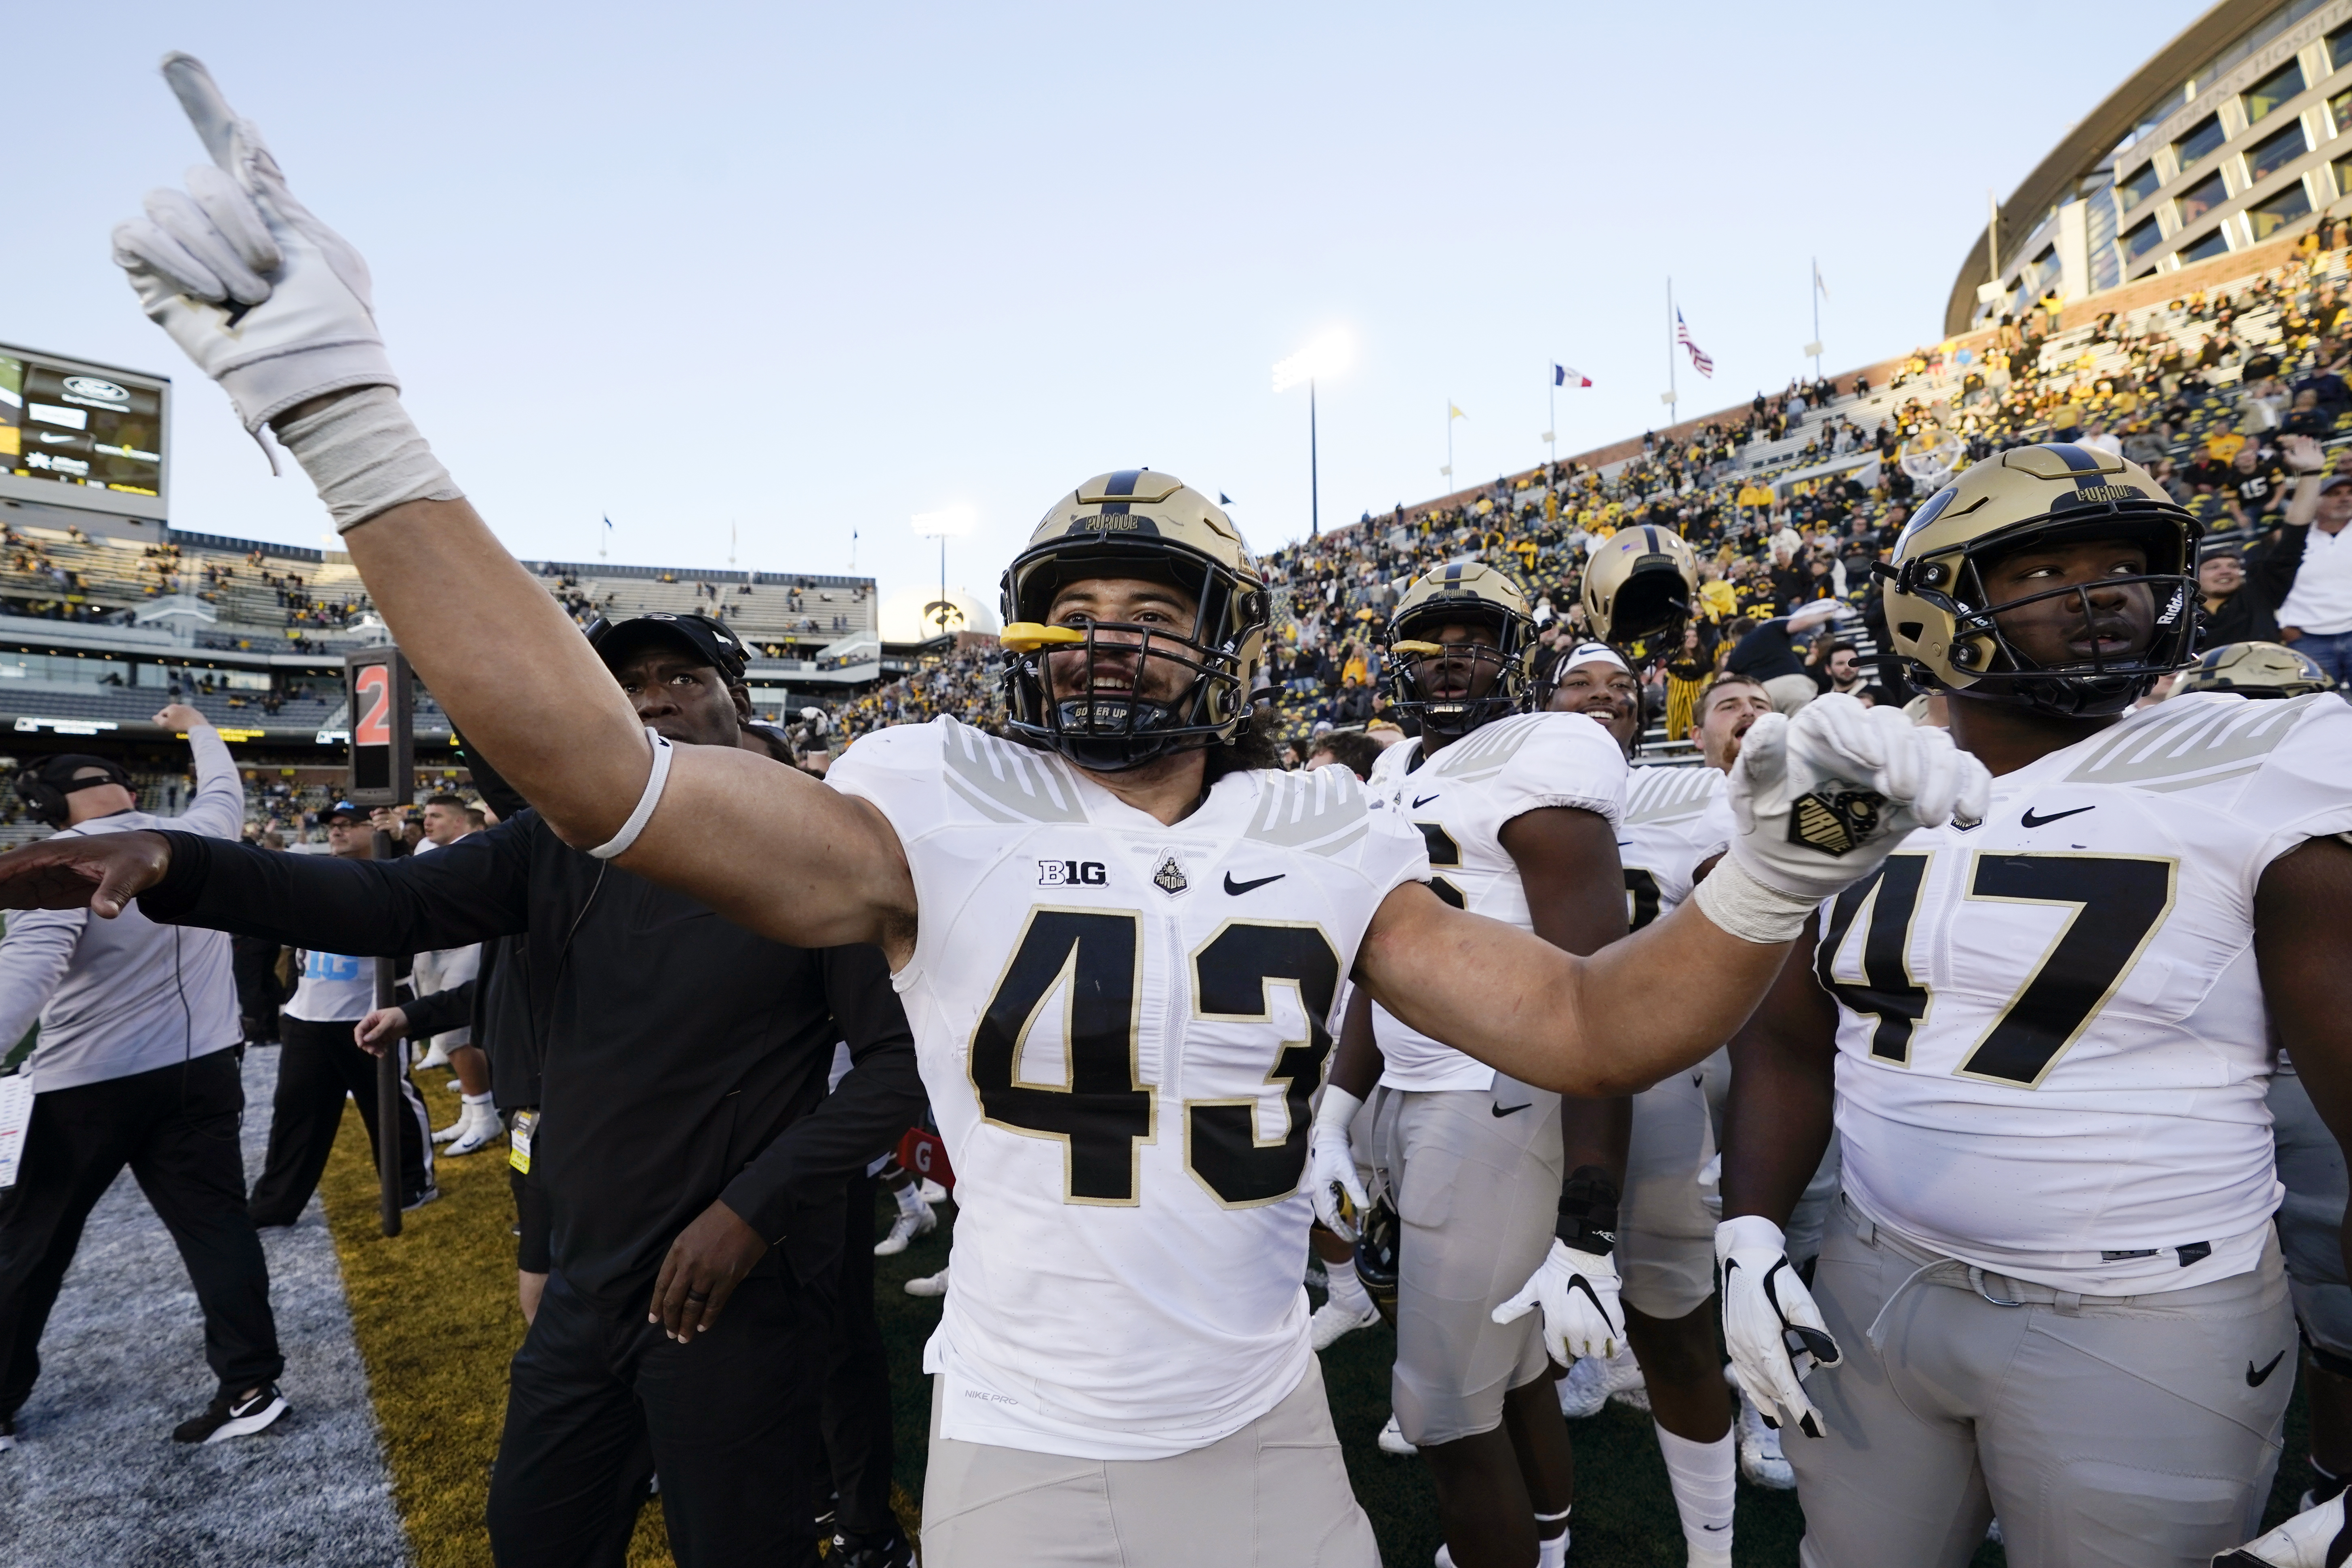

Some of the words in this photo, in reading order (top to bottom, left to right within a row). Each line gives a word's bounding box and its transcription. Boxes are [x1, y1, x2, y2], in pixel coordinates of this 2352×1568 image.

[2075, 485, 2132, 502] PURDUE
[2240, 476, 2268, 499] 15
[1085, 512, 1139, 530] PURDUE
[2156, 585, 2182, 624] Ridde
[356, 664, 390, 746] 2
[1075, 707, 1110, 717] BOER
[1112, 708, 1127, 718] UP
[1798, 798, 1851, 852] PURDUE
[1156, 875, 1186, 889] PURDUE
[1813, 849, 2181, 1091] 47
[966, 903, 1343, 1210] 43
[916, 1141, 932, 1172] G
[965, 1390, 990, 1400] NIKE
[991, 1394, 1018, 1405] PRO
